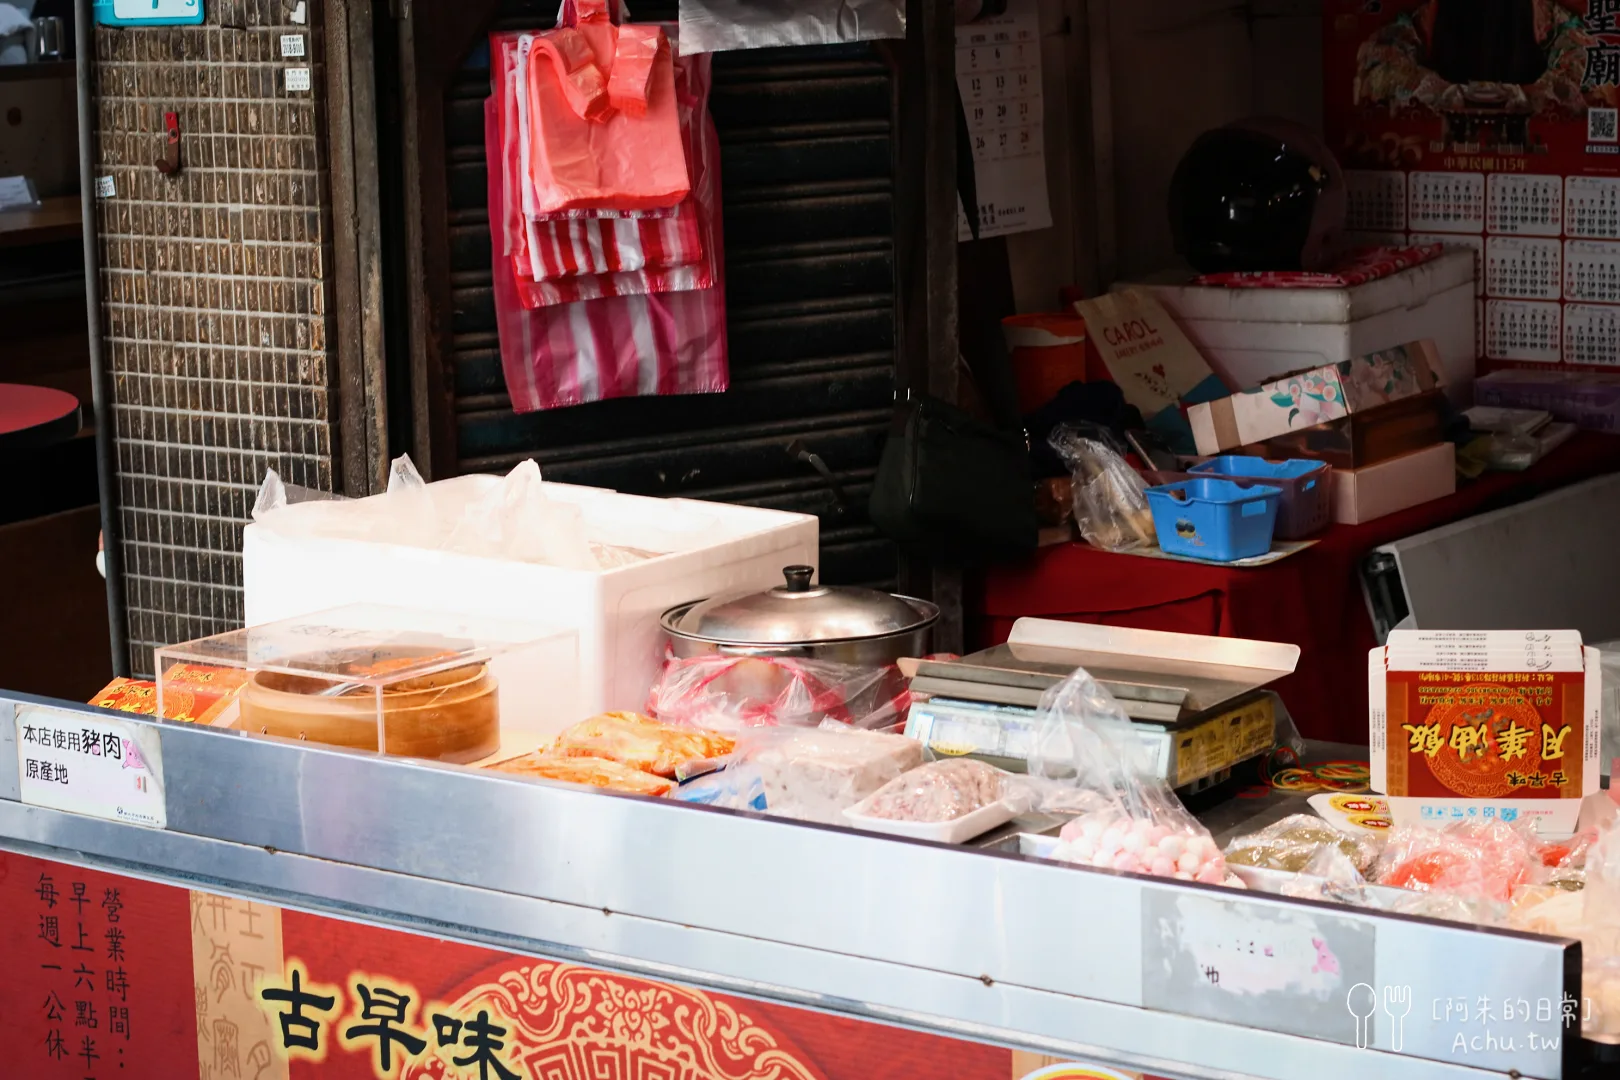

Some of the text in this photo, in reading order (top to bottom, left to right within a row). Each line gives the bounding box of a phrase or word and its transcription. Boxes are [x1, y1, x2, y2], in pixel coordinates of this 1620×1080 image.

[972, 73, 1028, 91] 12 13 14
[974, 102, 1028, 120] 19 20 21
[976, 136, 986, 150] 26
[999, 134, 1008, 146] 27
[1103, 318, 1158, 346] CAROL
[23, 724, 122, 760] 本店使用豬肉
[1400, 720, 1572, 762] 月華油飯
[26, 758, 68, 784] 原產地
[1505, 772, 1567, 788] 古早味
[35, 872, 70, 1061] 每週一公休
[68, 882, 101, 1080] 早上六點半
[261, 969, 522, 1080] 古早味
